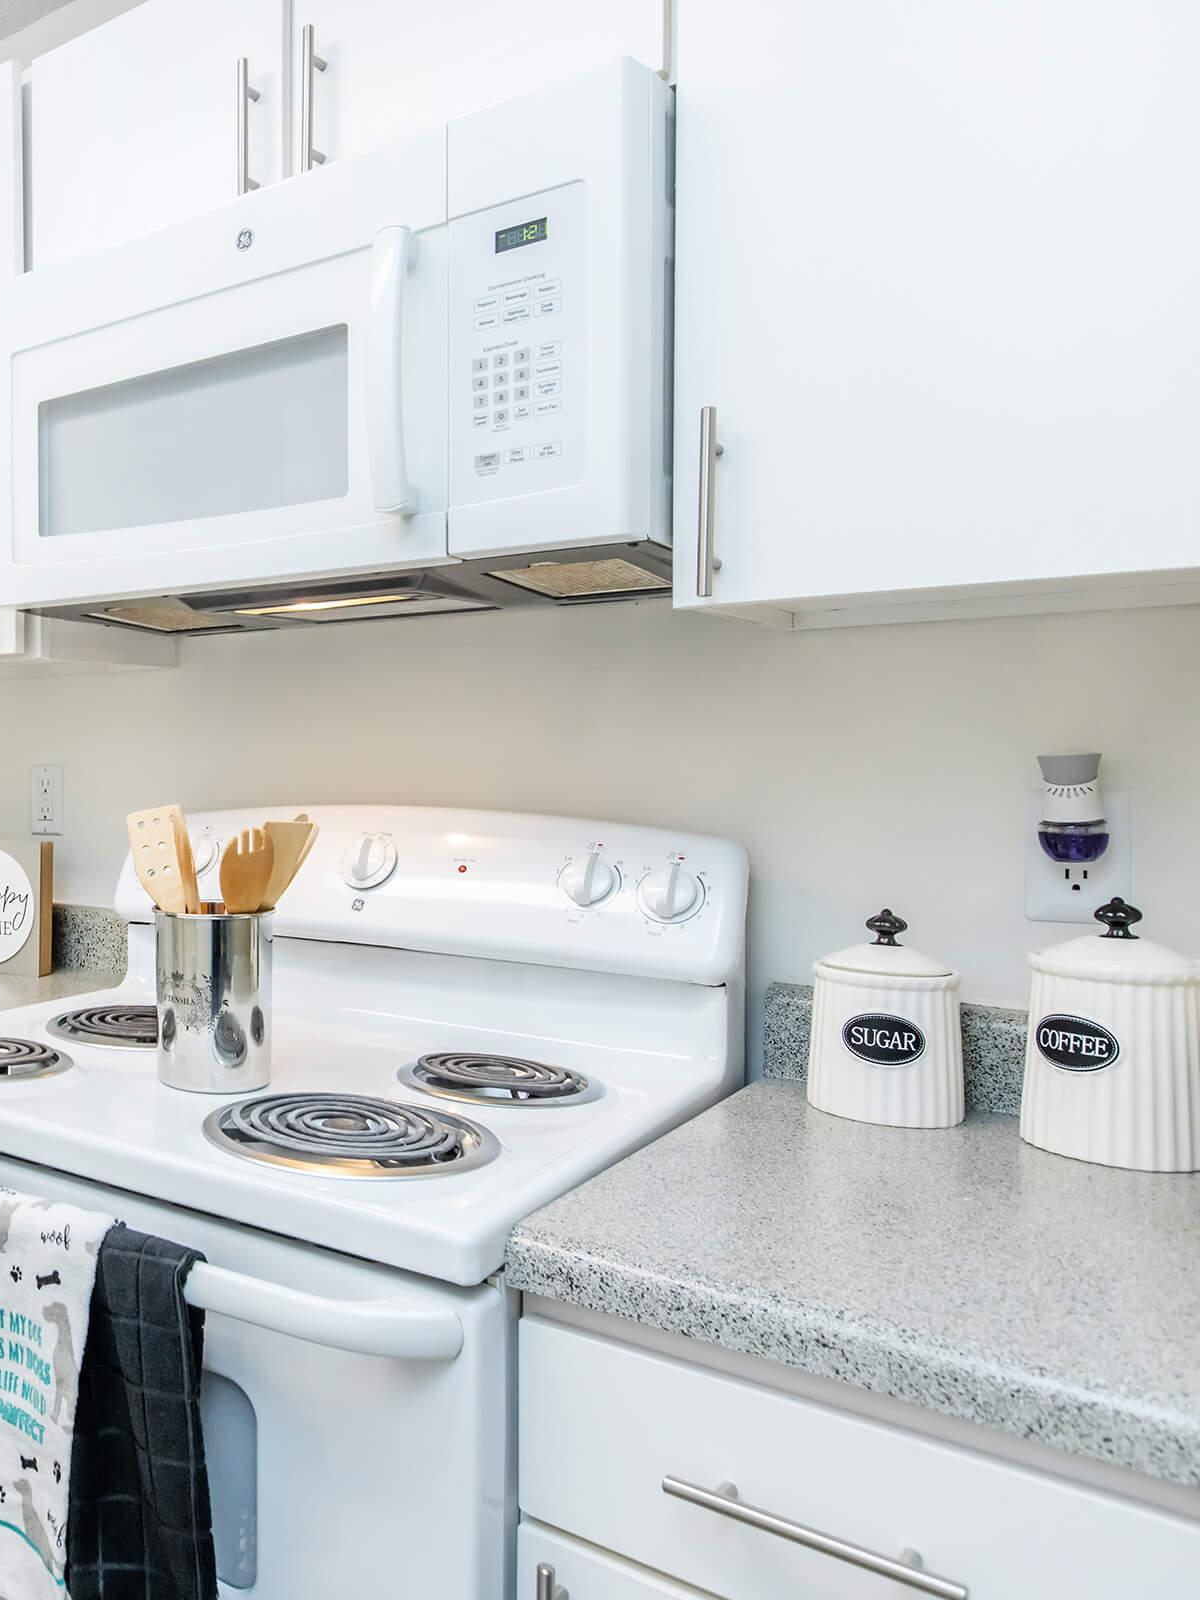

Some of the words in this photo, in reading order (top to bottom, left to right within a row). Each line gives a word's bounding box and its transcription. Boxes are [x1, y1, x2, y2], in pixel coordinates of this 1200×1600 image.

[850, 1026, 917, 1052] SUGAR
[1039, 1027, 1110, 1059] COFFEE
[40, 1223, 71, 1251] woof
[9, 1311, 27, 1337] MY
[8, 1340, 25, 1366] MY
